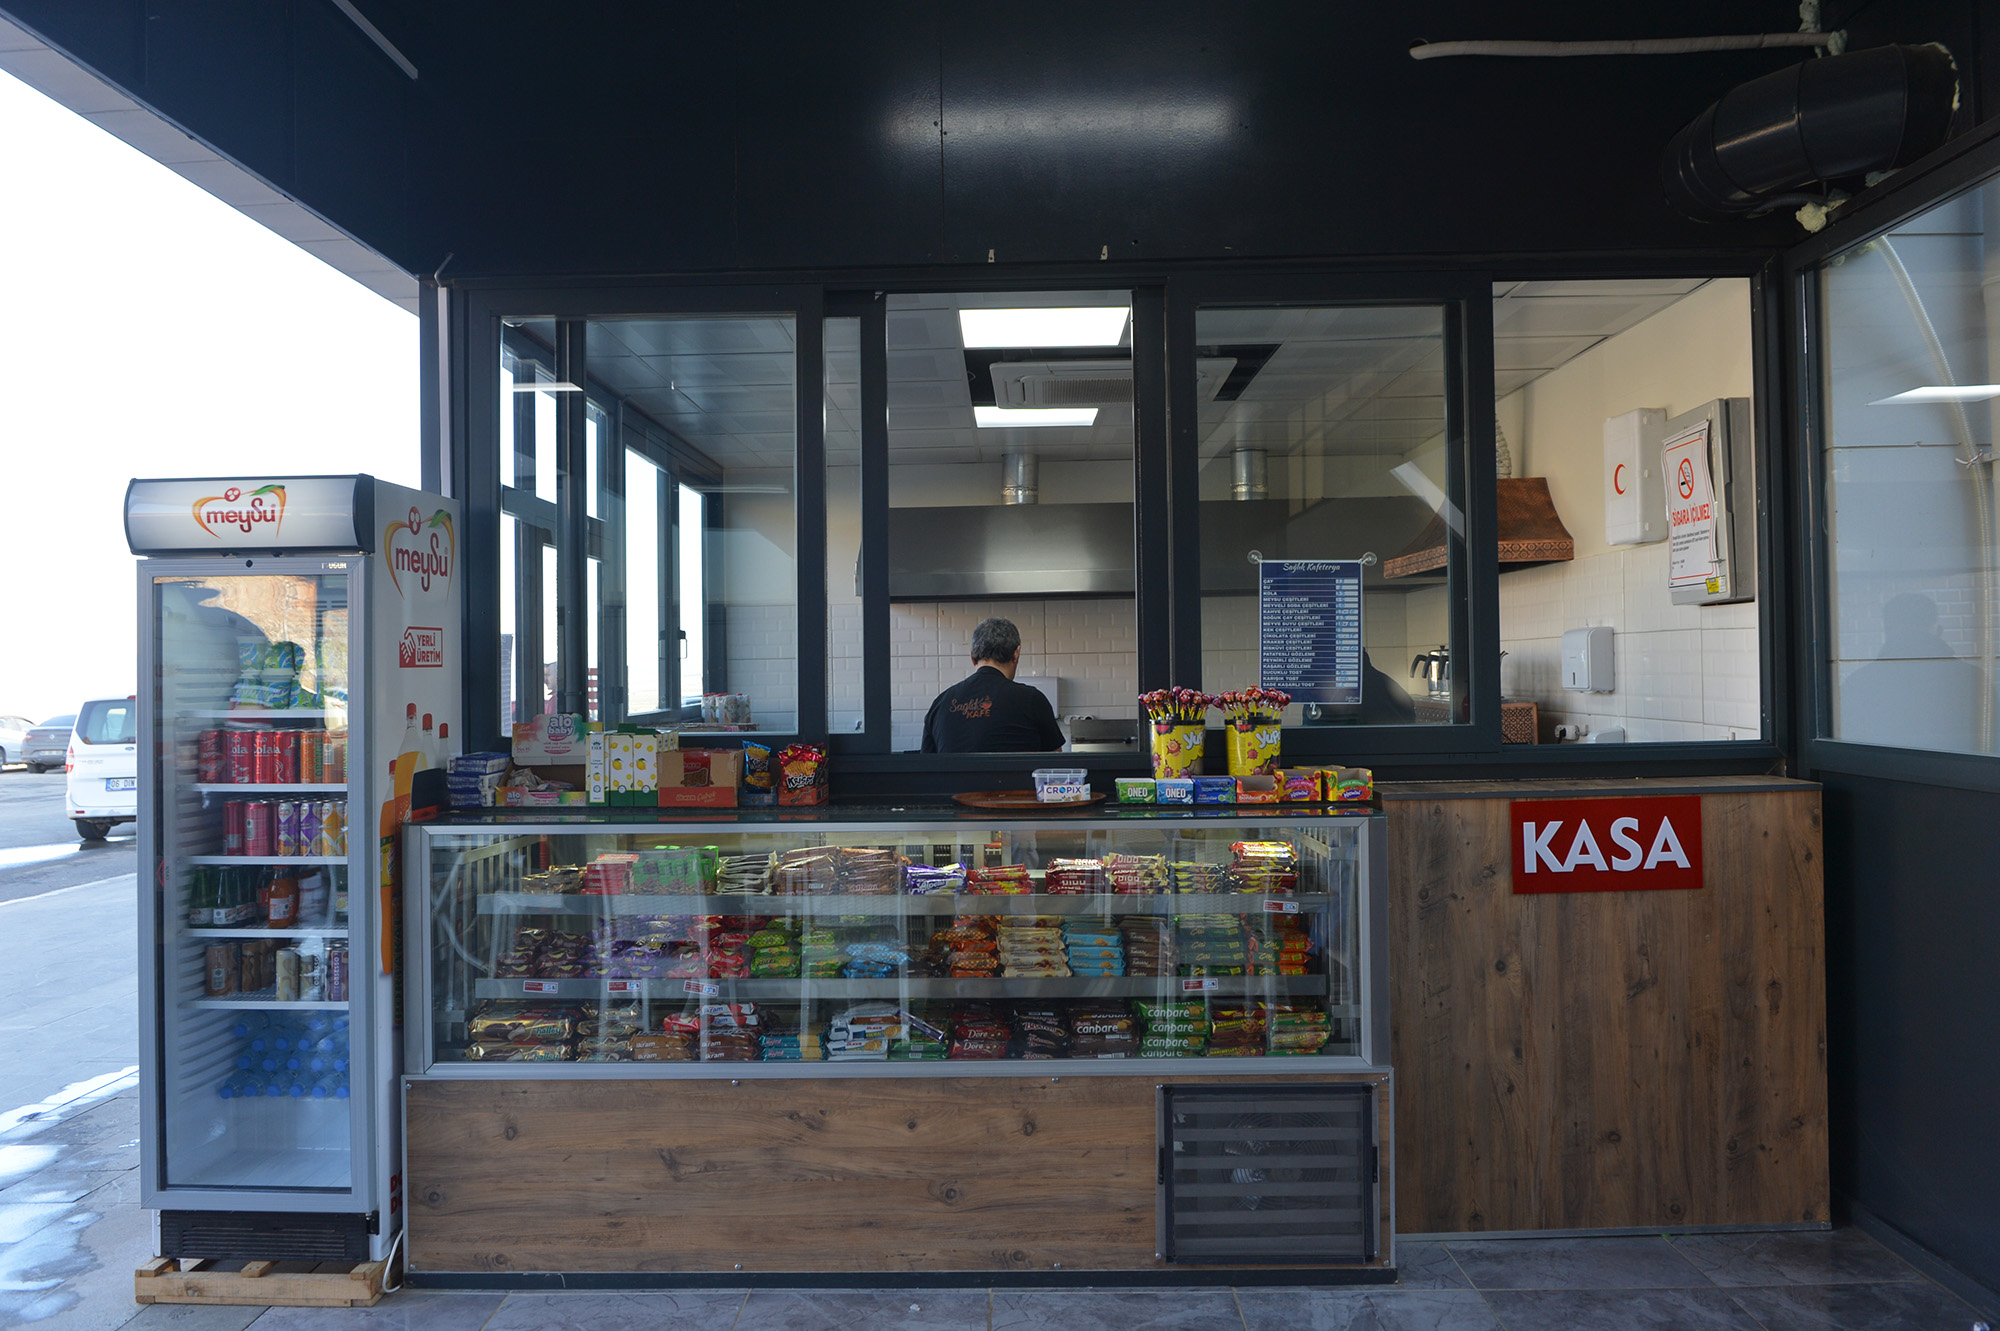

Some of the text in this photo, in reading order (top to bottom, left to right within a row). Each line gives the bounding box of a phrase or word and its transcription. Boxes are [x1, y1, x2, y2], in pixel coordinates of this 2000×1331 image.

[1307, 562, 1340, 573] Kafeterya
[417, 632, 436, 647] YERLİ
[417, 649, 440, 663] ÜRETİM
[966, 709, 990, 719] KAFE
[550, 715, 572, 727] alo
[548, 725, 573, 736] baby
[1127, 787, 1148, 797] ONEO
[1165, 788, 1186, 798] ONEO
[1523, 815, 1691, 873] KASA
